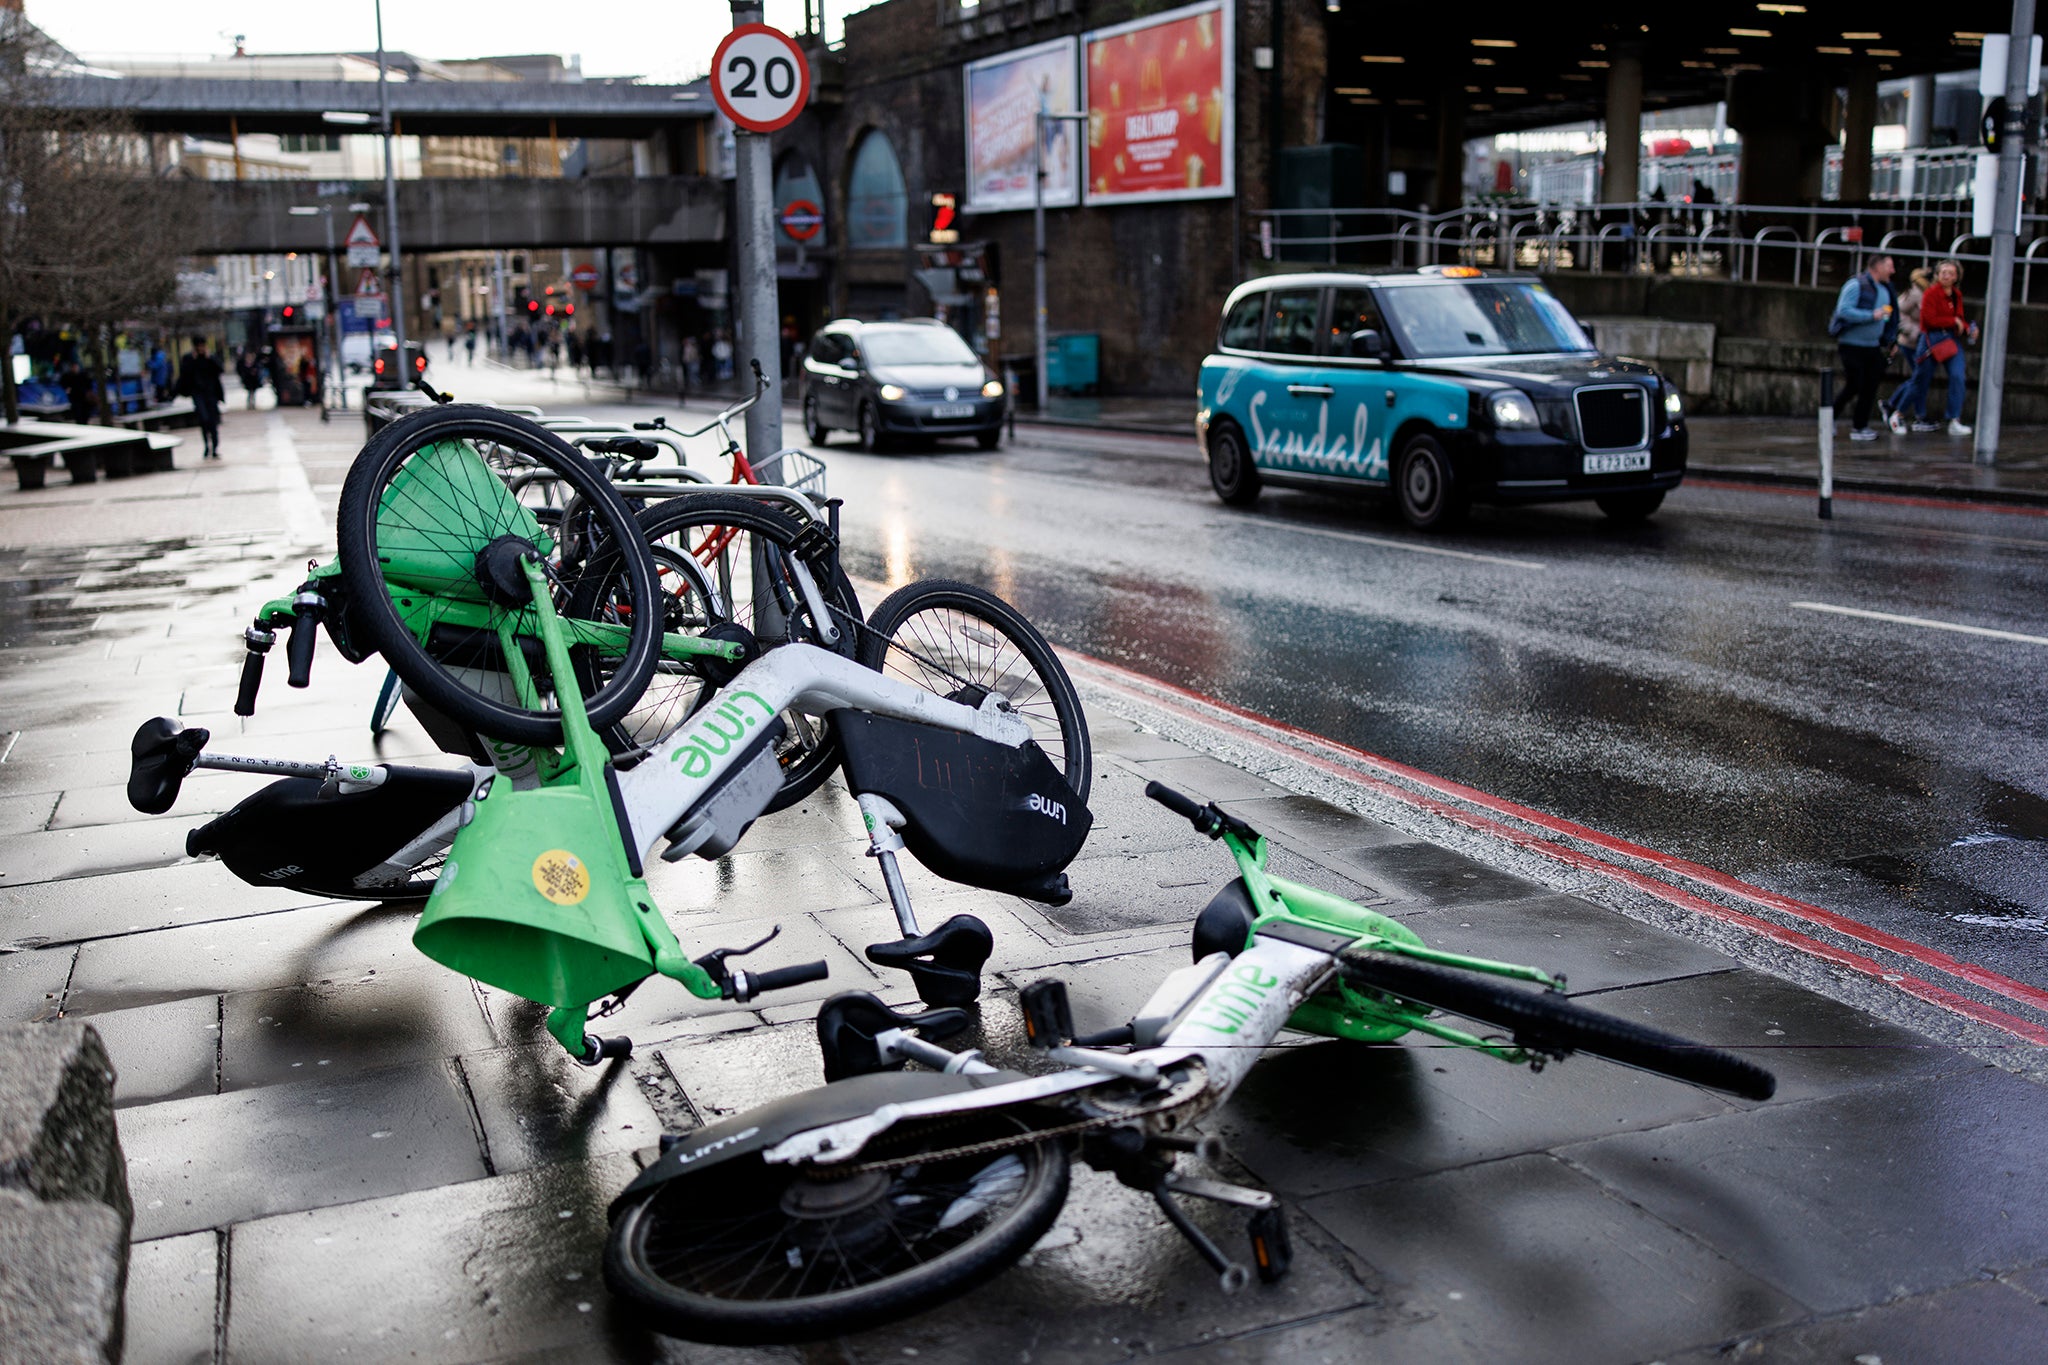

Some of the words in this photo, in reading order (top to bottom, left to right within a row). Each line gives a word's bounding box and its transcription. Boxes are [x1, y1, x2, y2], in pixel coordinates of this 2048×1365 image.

[728, 56, 795, 99] 20
[1250, 390, 1389, 478] Sandals
[671, 690, 775, 778] Lime
[1029, 793, 1067, 825] Lime
[260, 865, 304, 880] Lime
[1187, 964, 1278, 1034] Lime
[679, 1126, 760, 1164] Lime
